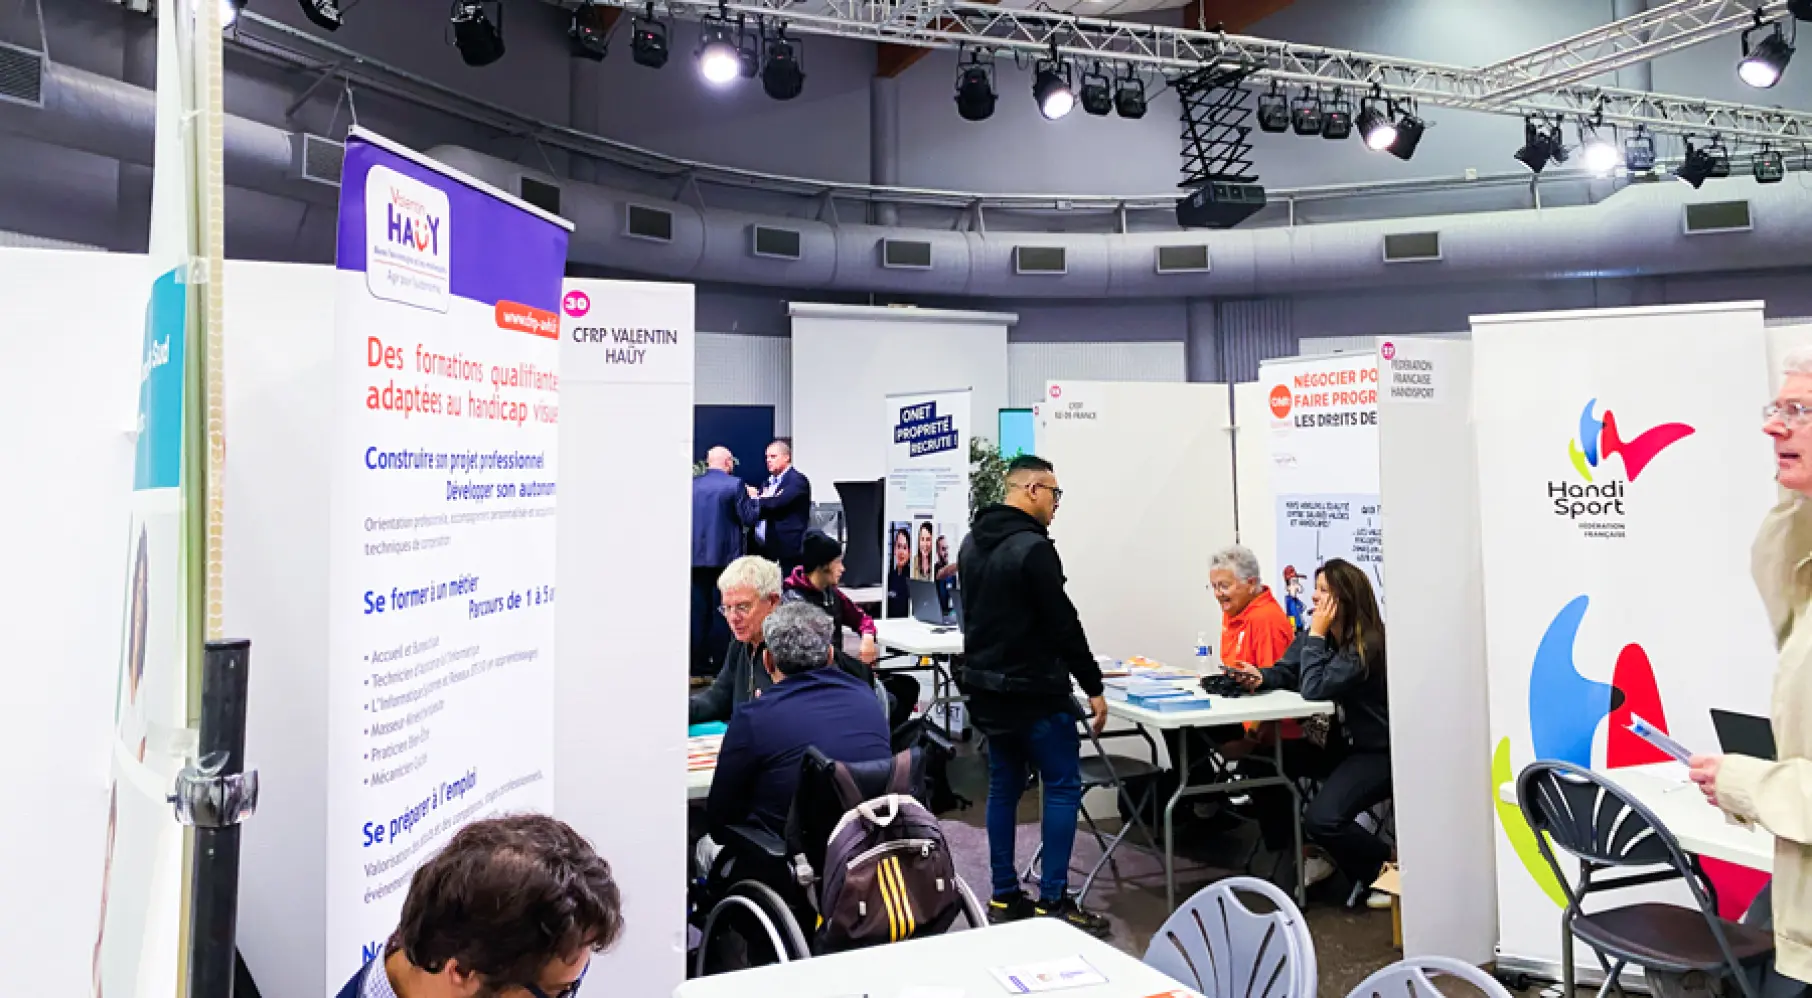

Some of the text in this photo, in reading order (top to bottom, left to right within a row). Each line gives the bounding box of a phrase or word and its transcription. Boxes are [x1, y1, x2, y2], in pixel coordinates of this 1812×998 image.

[565, 297, 588, 311] 30
[572, 327, 678, 345] CFRP VALENTIN
[367, 335, 403, 371] Des
[416, 342, 484, 384] formations
[1294, 371, 1356, 389] NÉGOCIER
[366, 378, 442, 420] adaptées
[446, 394, 463, 417] au
[468, 388, 529, 429] handicap
[1294, 389, 1378, 408] FAIRE PROGR
[902, 404, 932, 424] ONET
[1294, 413, 1316, 428] LES
[1318, 411, 1358, 428] DROITS
[1360, 409, 1378, 426] DE
[912, 433, 951, 454] RECRUTE
[364, 445, 434, 470] Construire
[479, 449, 545, 476] professionnel
[497, 483, 517, 499] son
[1547, 480, 1624, 498] Handi
[1554, 498, 1625, 520] Sport
[363, 590, 386, 615] Se
[391, 586, 430, 612] former
[449, 573, 481, 598] métier
[469, 598, 504, 621] Parcours
[506, 589, 522, 611] de
[363, 820, 386, 848] Se
[389, 796, 431, 844] préparer
[439, 766, 477, 806] l'emploi
